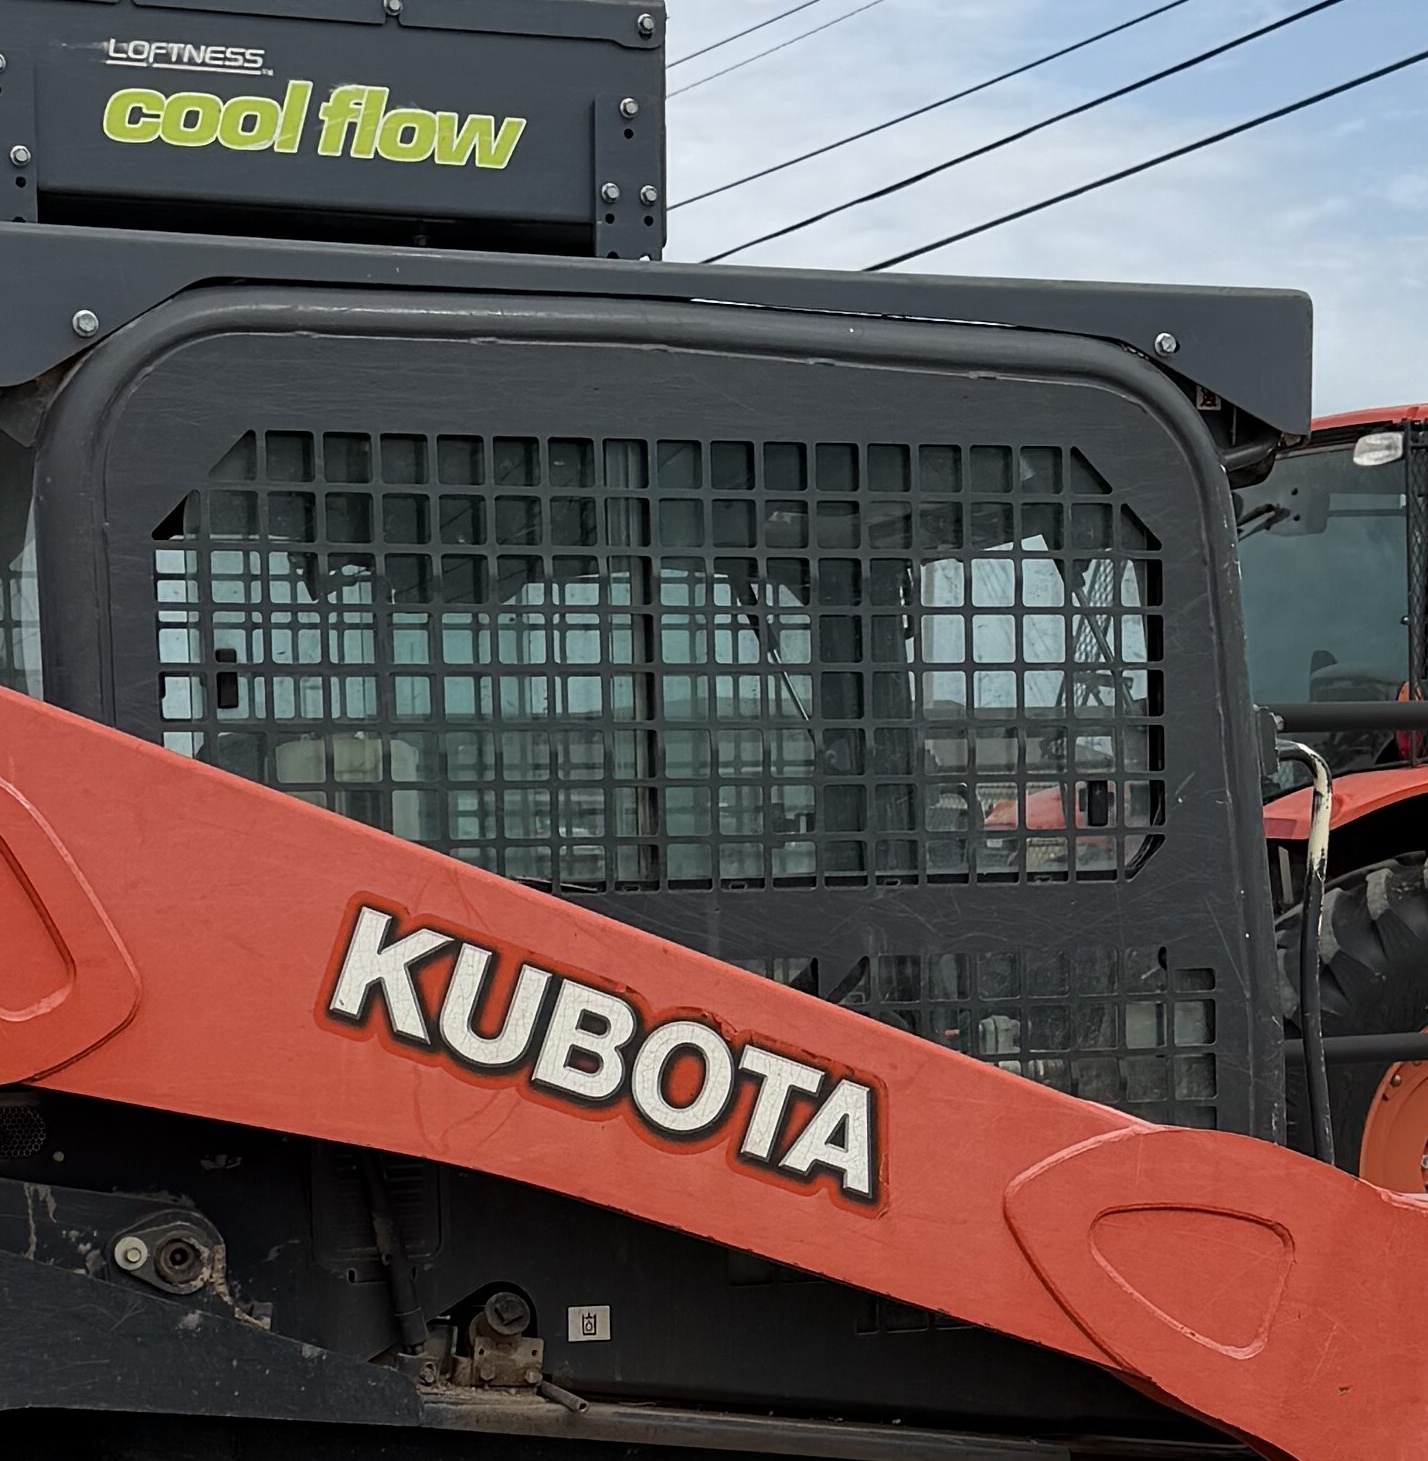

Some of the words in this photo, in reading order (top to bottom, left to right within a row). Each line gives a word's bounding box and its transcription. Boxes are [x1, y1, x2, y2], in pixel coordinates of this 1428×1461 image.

[108, 38, 265, 68] LOFTNESS
[103, 80, 313, 154] cool
[318, 83, 526, 170] flow
[329, 906, 872, 1199] KUBOTA
